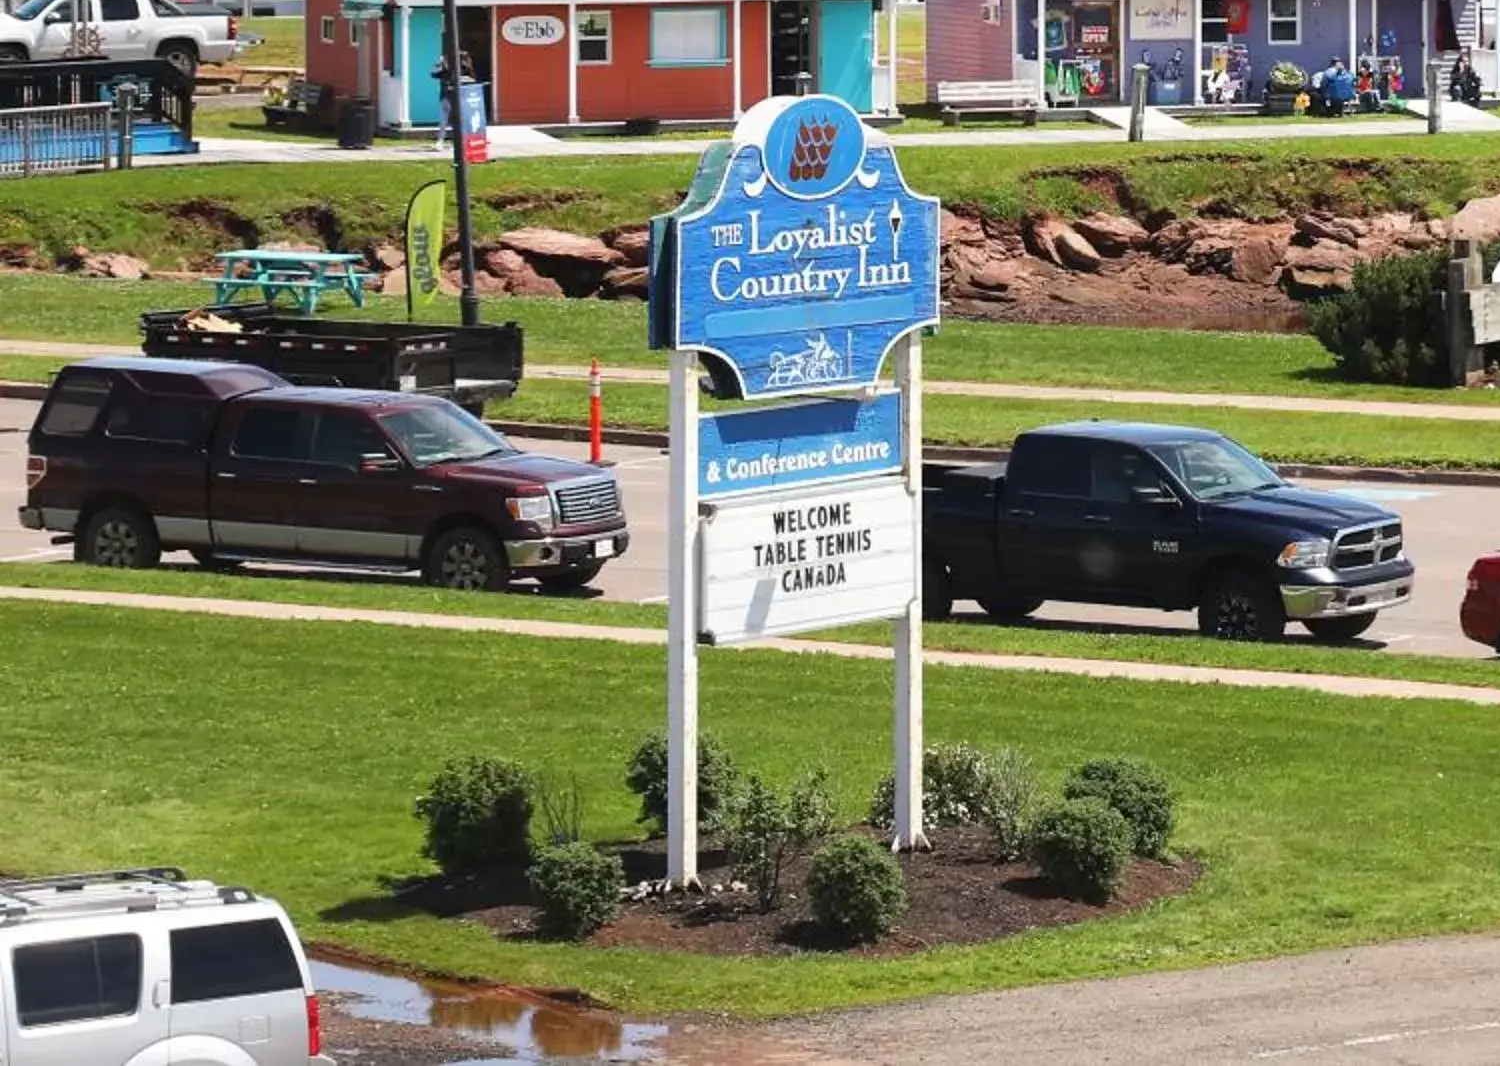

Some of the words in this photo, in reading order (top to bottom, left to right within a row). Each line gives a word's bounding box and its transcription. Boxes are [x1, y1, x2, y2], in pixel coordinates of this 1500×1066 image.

[711, 223, 743, 246] THE
[748, 204, 877, 259] Loyalist
[711, 256, 852, 301] Country
[858, 244, 911, 287] Inn
[707, 459, 721, 483] &
[726, 450, 828, 481] Conference
[831, 440, 890, 464] Centre
[773, 502, 852, 534] WELCOME
[754, 539, 806, 567] TABLE
[816, 529, 871, 558] TENNIS
[782, 562, 846, 593] CANADA
